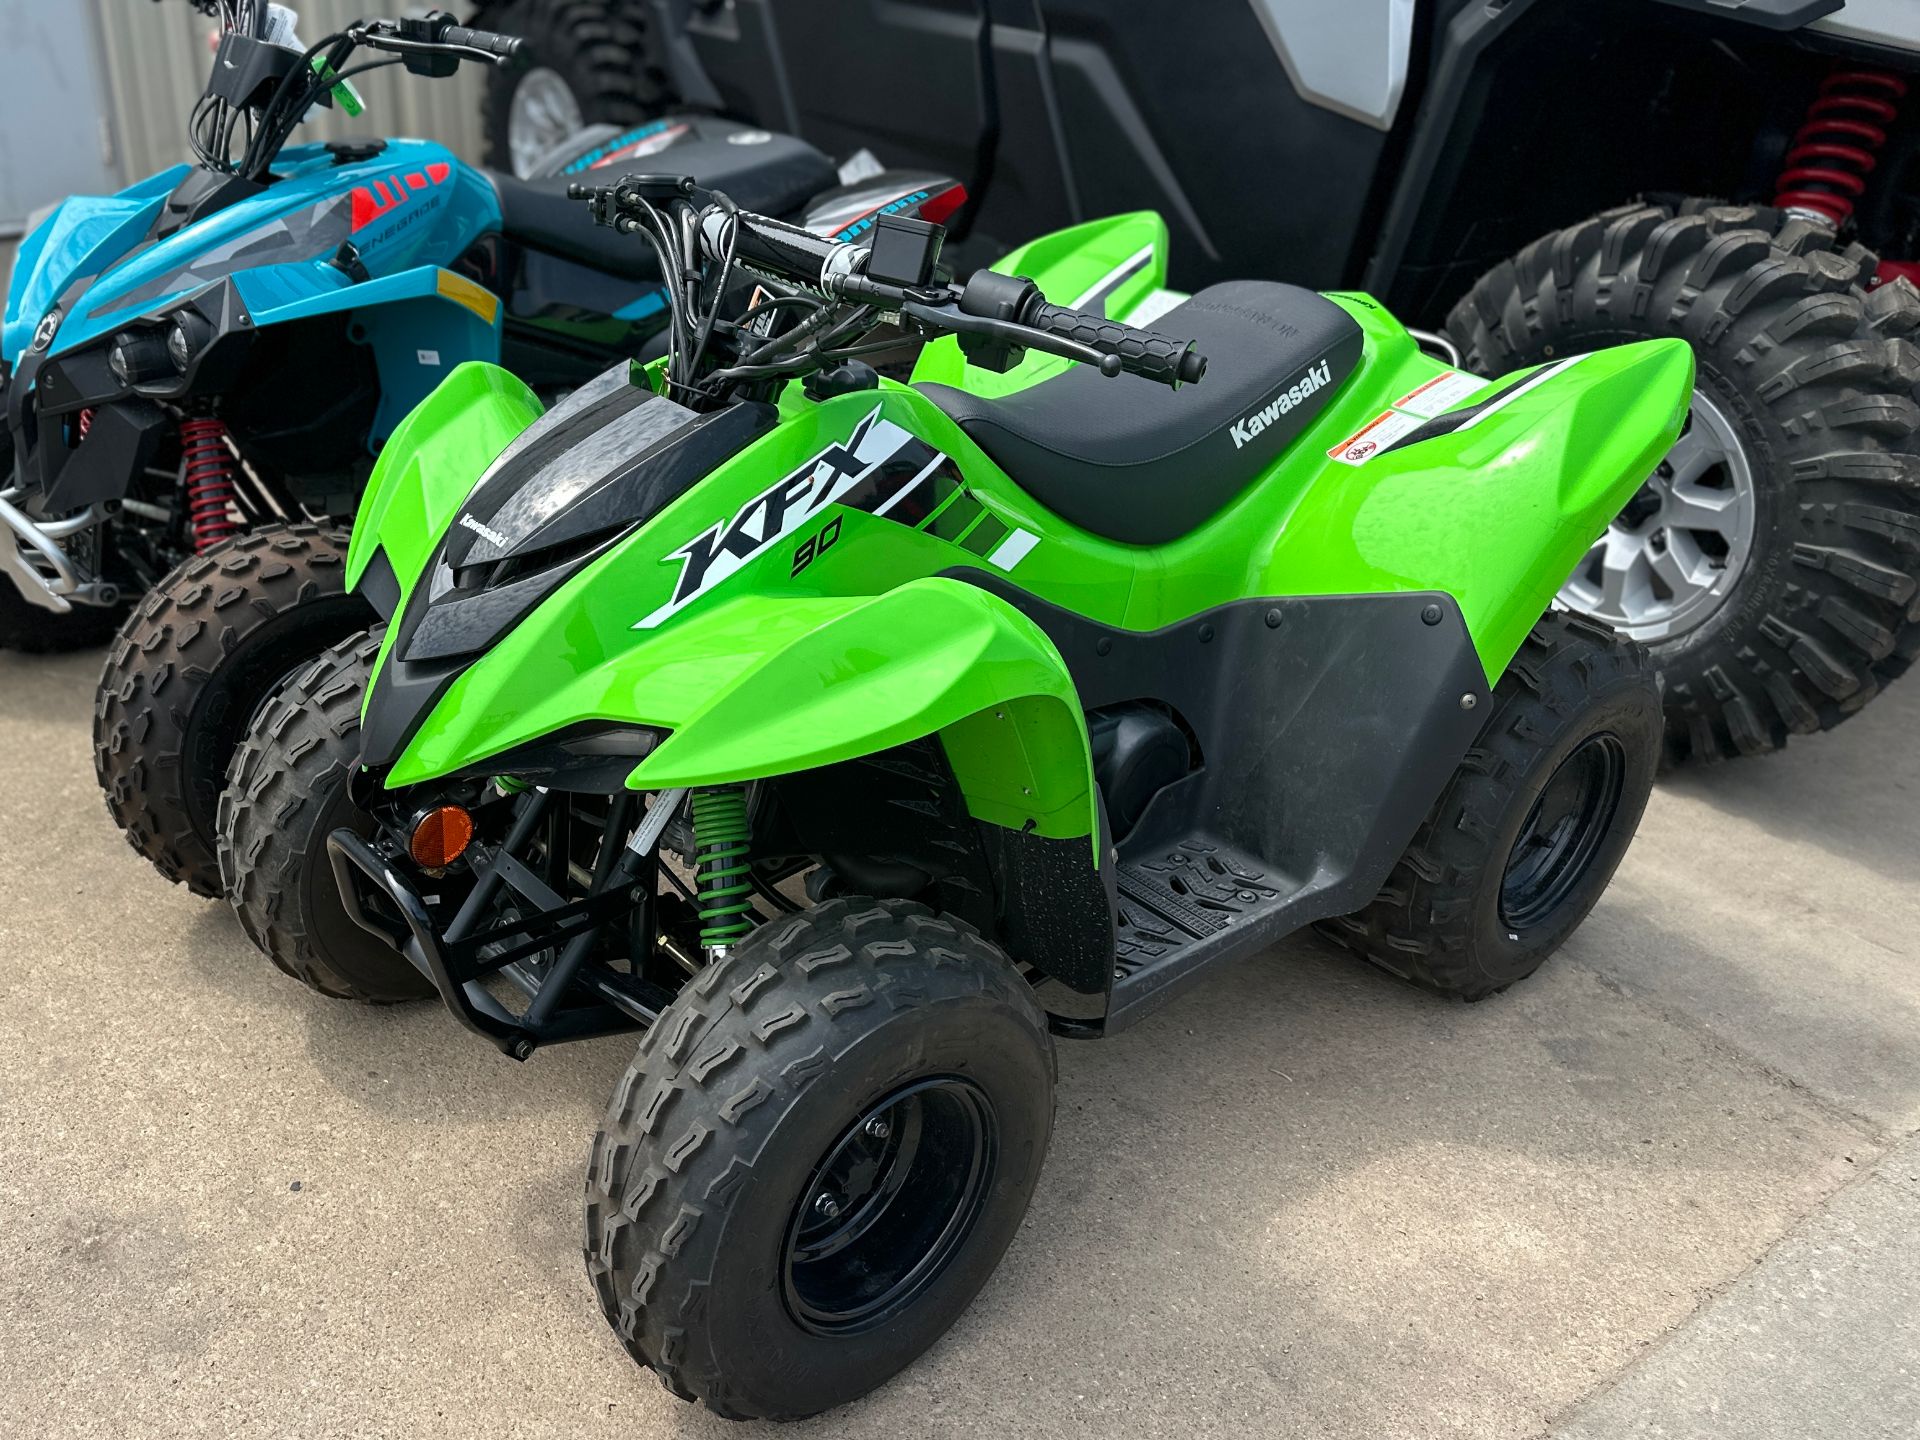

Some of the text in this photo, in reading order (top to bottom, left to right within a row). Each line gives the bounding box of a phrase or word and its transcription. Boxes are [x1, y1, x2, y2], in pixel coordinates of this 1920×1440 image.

[359, 195, 441, 256] ENEGADE
[837, 190, 929, 243] an-am
[1229, 358, 1332, 449] Kawasaki
[459, 512, 510, 548] Kawasaki
[672, 411, 876, 606] KFX
[789, 513, 844, 582] 90
